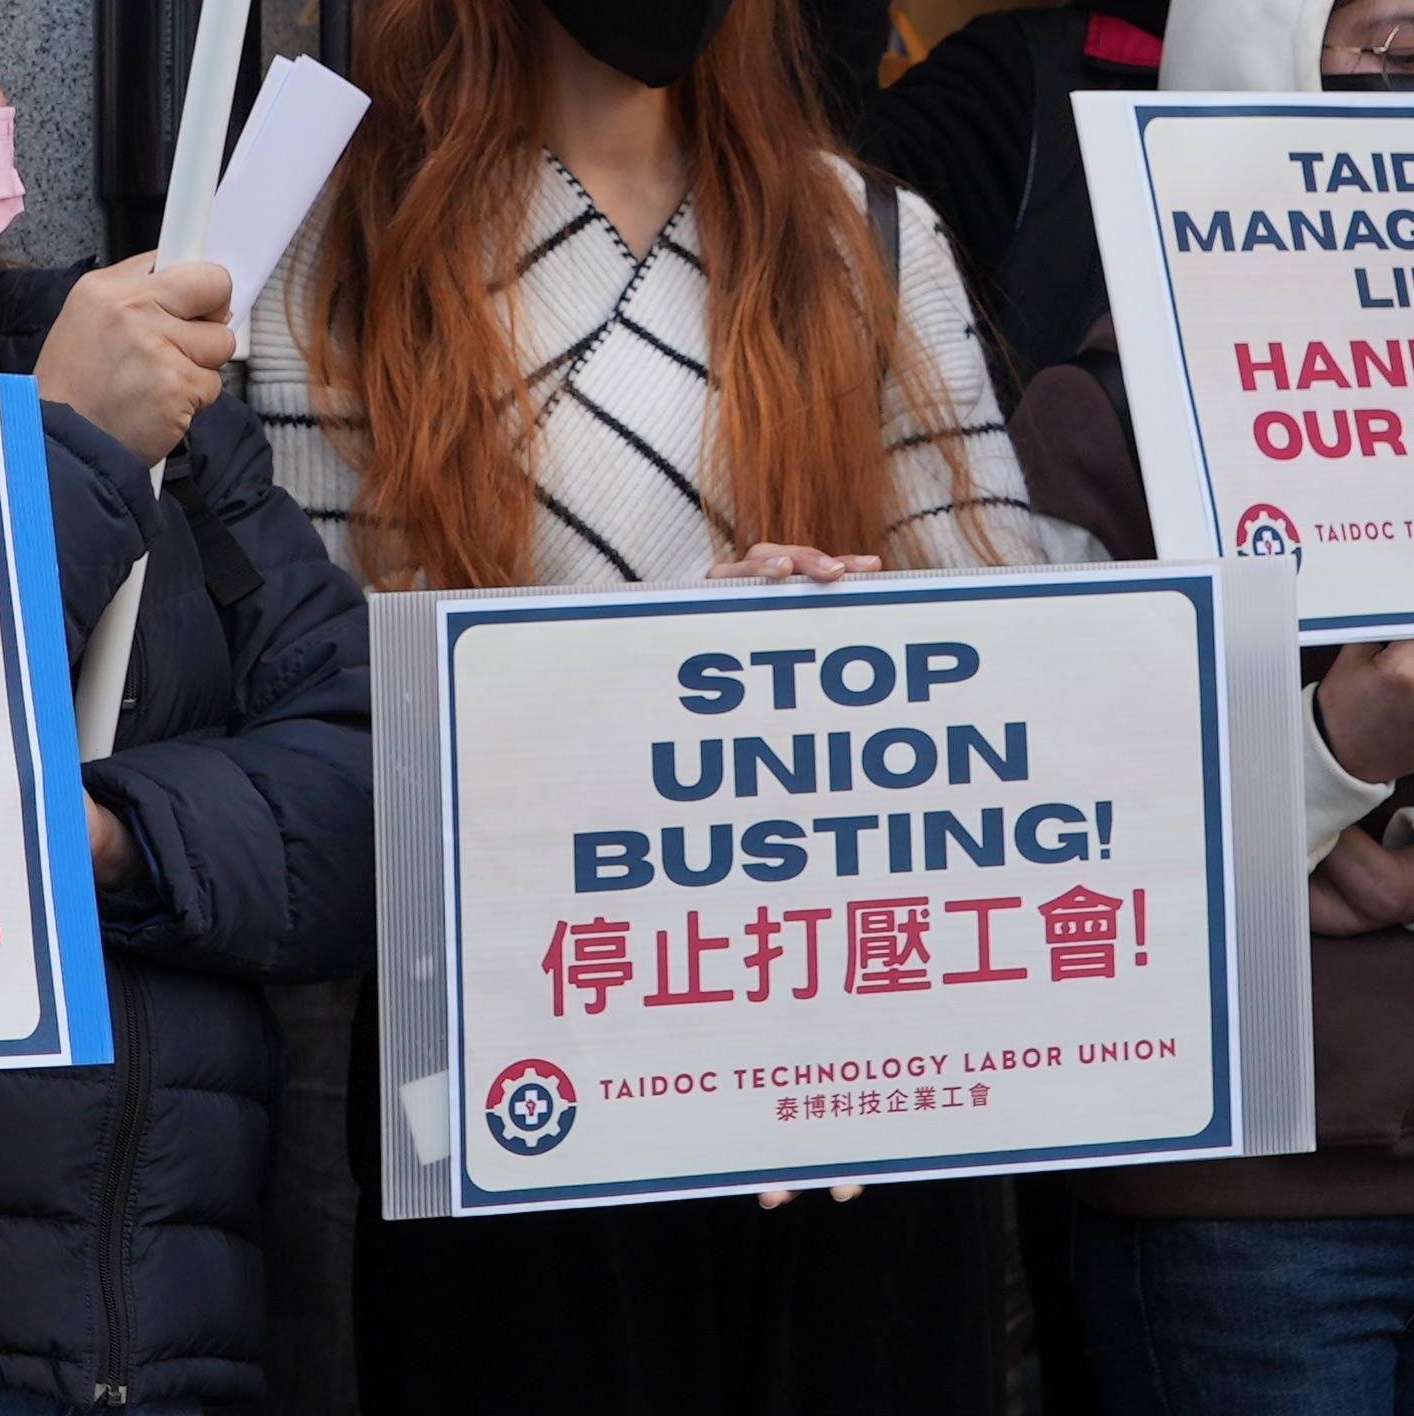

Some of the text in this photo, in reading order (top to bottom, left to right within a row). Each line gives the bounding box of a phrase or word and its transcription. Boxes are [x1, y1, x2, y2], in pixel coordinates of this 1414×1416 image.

[1253, 409, 1407, 460] OUR
[1315, 522, 1394, 542] TAIDOC
[678, 642, 980, 715] STOP
[652, 722, 1028, 802] UNION
[573, 801, 1112, 893] BUSTING!
[542, 885, 1148, 1017] 停止打壓工會!
[600, 1038, 1175, 1099] TAIDOC TECHNOLOGY LABOR UNION
[776, 1083, 990, 1121] 泰博科技企業工會
